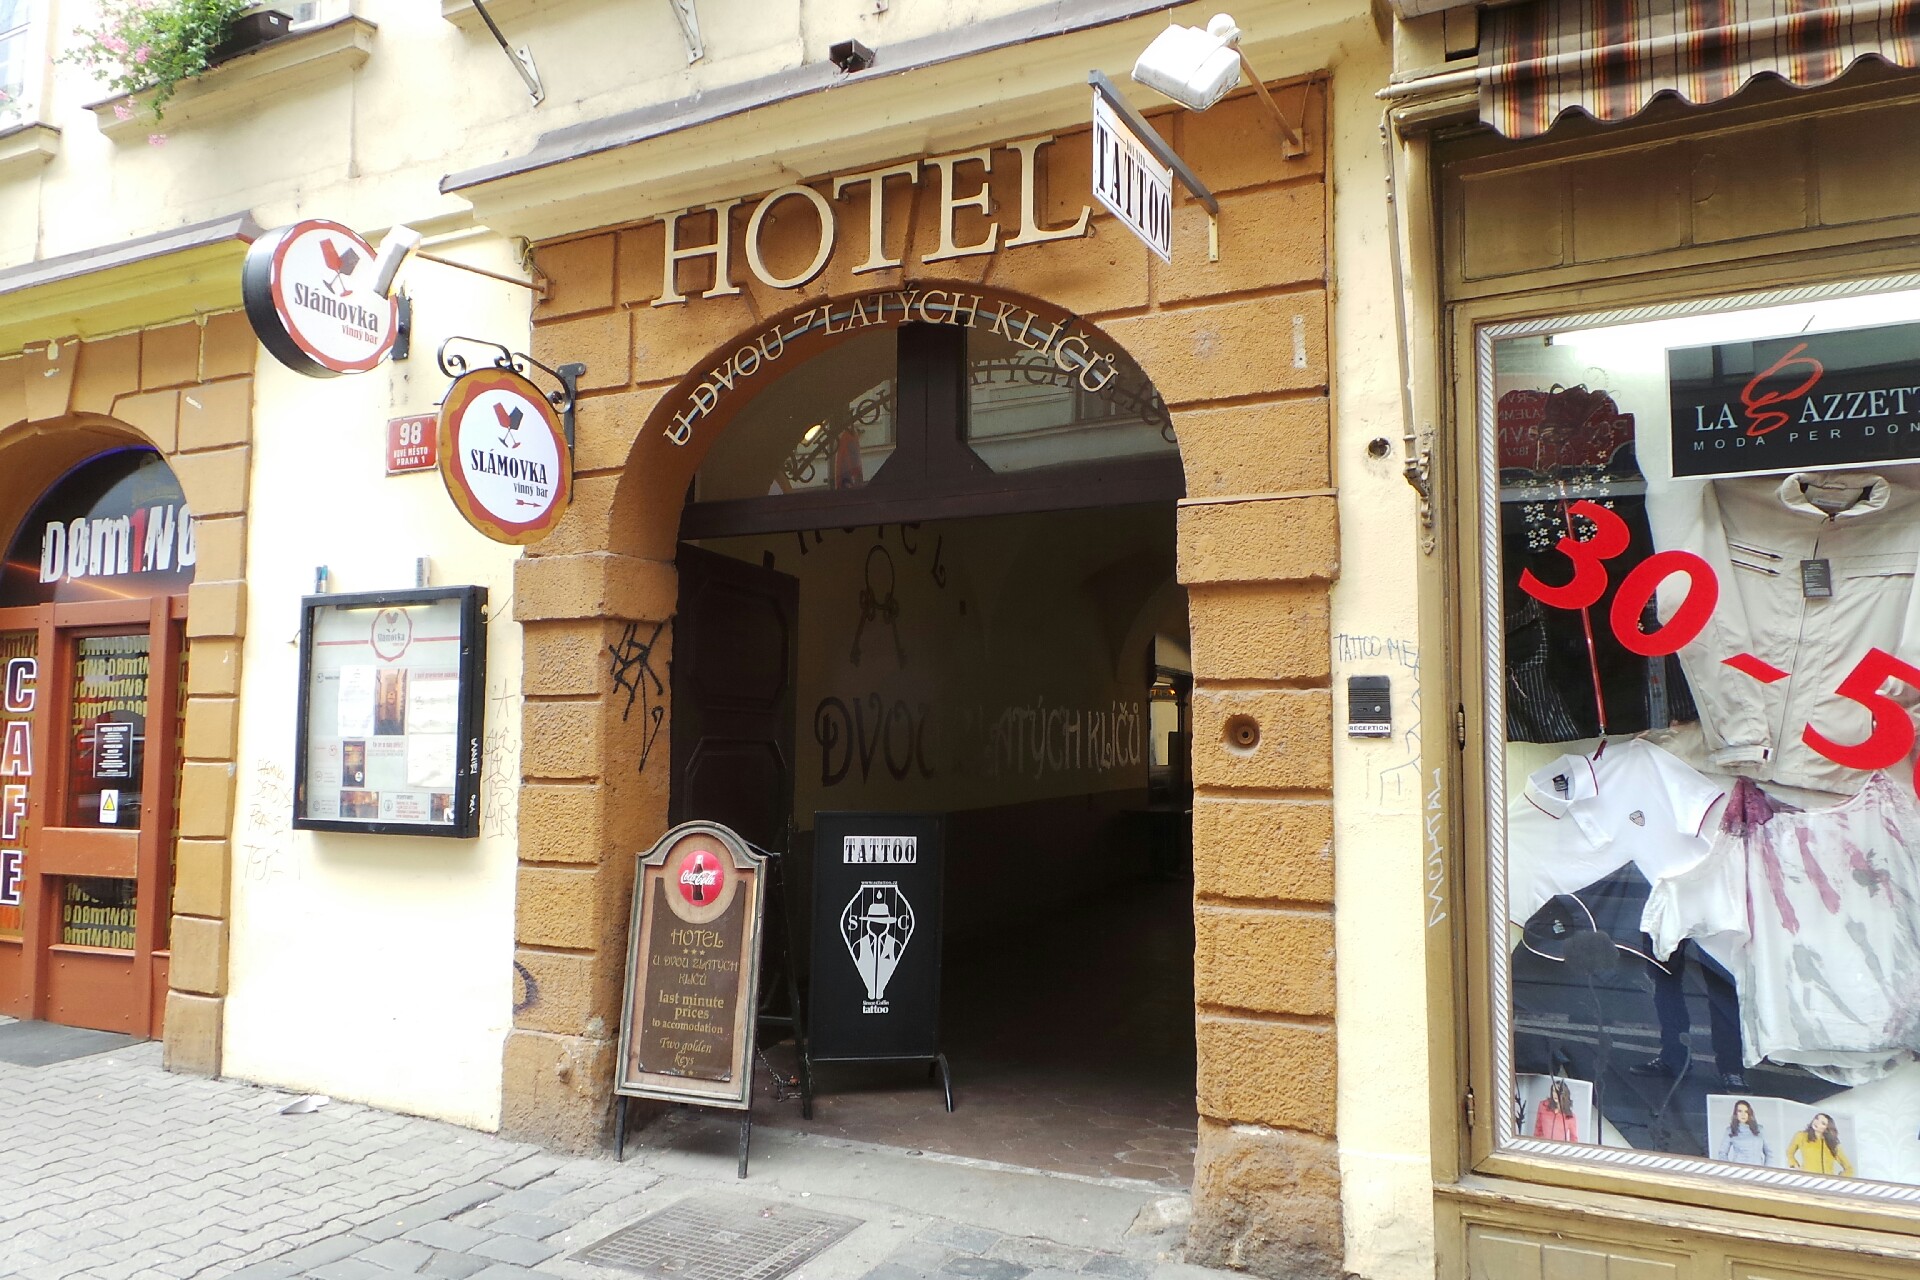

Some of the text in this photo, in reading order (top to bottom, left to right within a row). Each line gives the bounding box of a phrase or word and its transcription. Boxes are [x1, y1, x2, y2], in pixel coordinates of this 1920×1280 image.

[1097, 121, 1171, 253] TATTOO
[650, 134, 1092, 308] HOTEL
[294, 282, 379, 333] Slámovka
[364, 330, 378, 345] bar
[663, 282, 1119, 446] U DVOU ZLATÝCH KLÍČŮ
[1695, 402, 1738, 431] LA
[399, 421, 422, 446] 98
[1694, 435, 1766, 450] MODA
[1789, 428, 1841, 442] PER
[396, 454, 426, 466] PRAHA 1
[470, 448, 548, 485] SLÁMOVKA
[535, 483, 548, 498] bar
[1333, 633, 1381, 662] TATTOO
[1087, 700, 1141, 774] KLÍČŮ
[0, 656, 37, 906] CAFE
[845, 837, 915, 863] TATTOO
[847, 914, 910, 931] S C
[670, 928, 724, 948] HOTEL
[652, 954, 661, 966] U
[659, 989, 725, 1010] last minute
[862, 1004, 889, 1014] tattoo
[674, 1006, 710, 1021] prices
[652, 1017, 724, 1035] to accomodation
[660, 1036, 712, 1055] Two golden
[674, 1050, 696, 1069] keys
